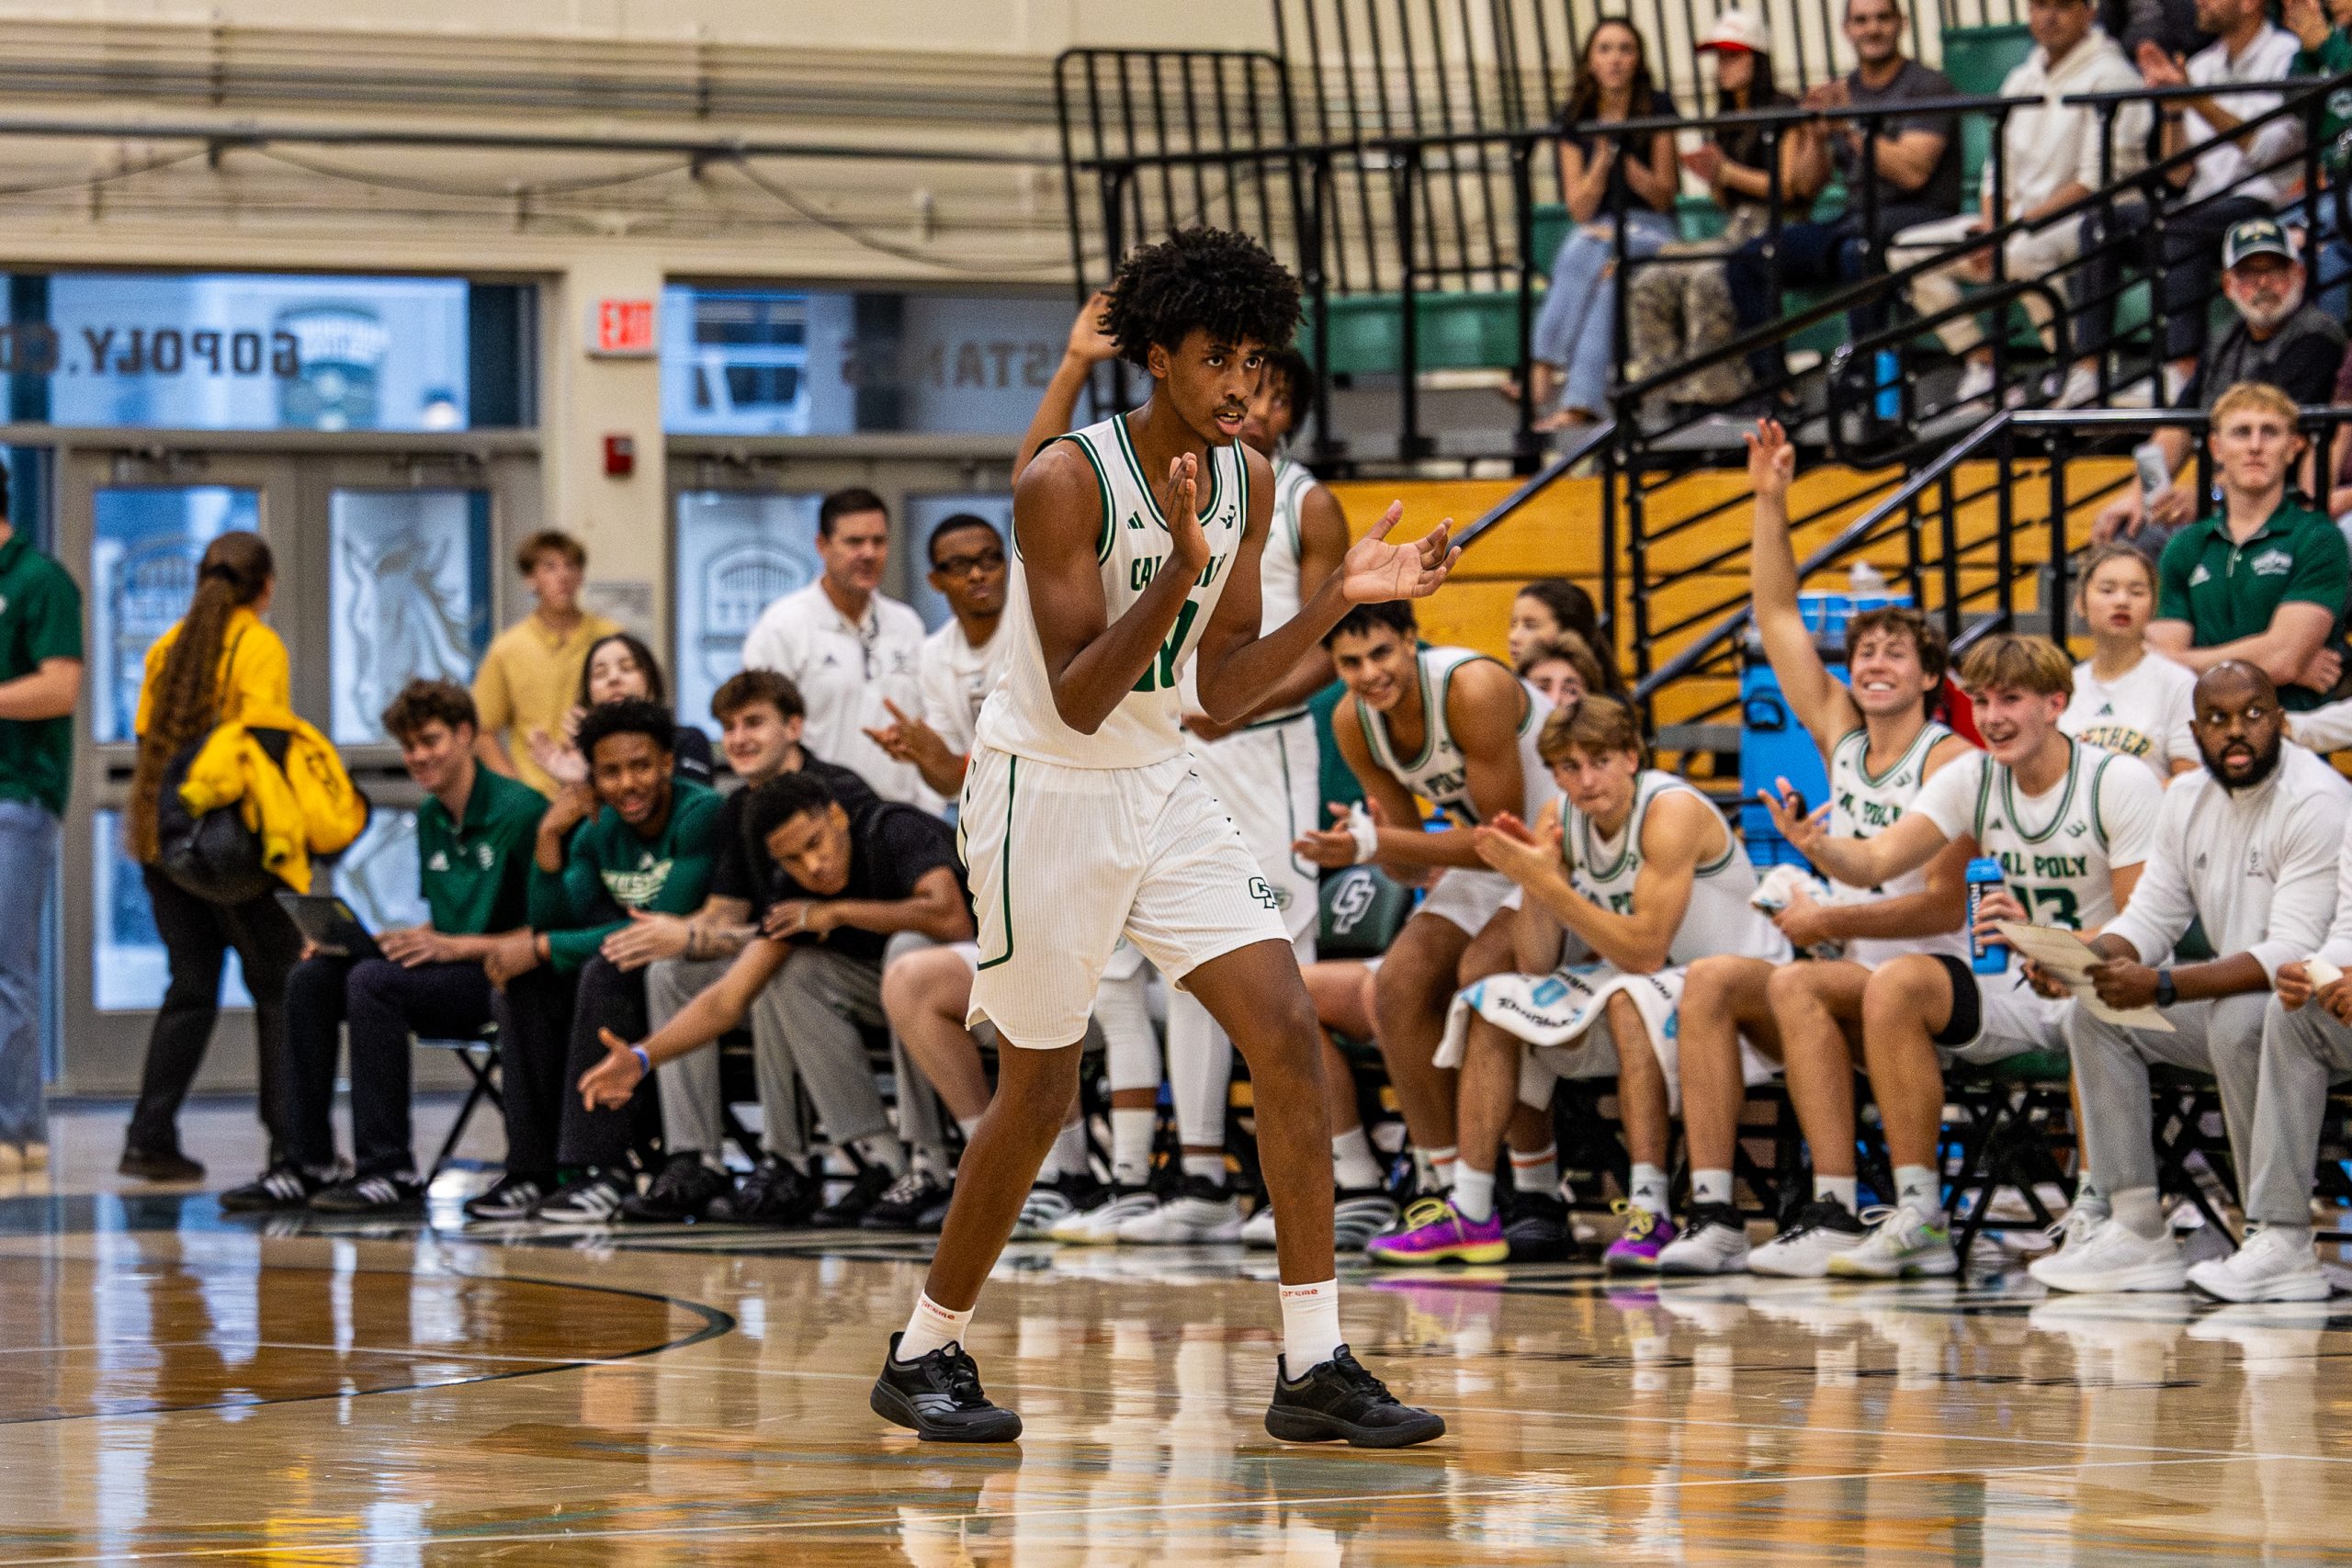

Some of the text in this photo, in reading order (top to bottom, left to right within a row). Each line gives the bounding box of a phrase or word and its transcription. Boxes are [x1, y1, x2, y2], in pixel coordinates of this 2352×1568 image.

[600, 300, 651, 350] EXIT
[1990, 851, 2087, 879] AL POLY
